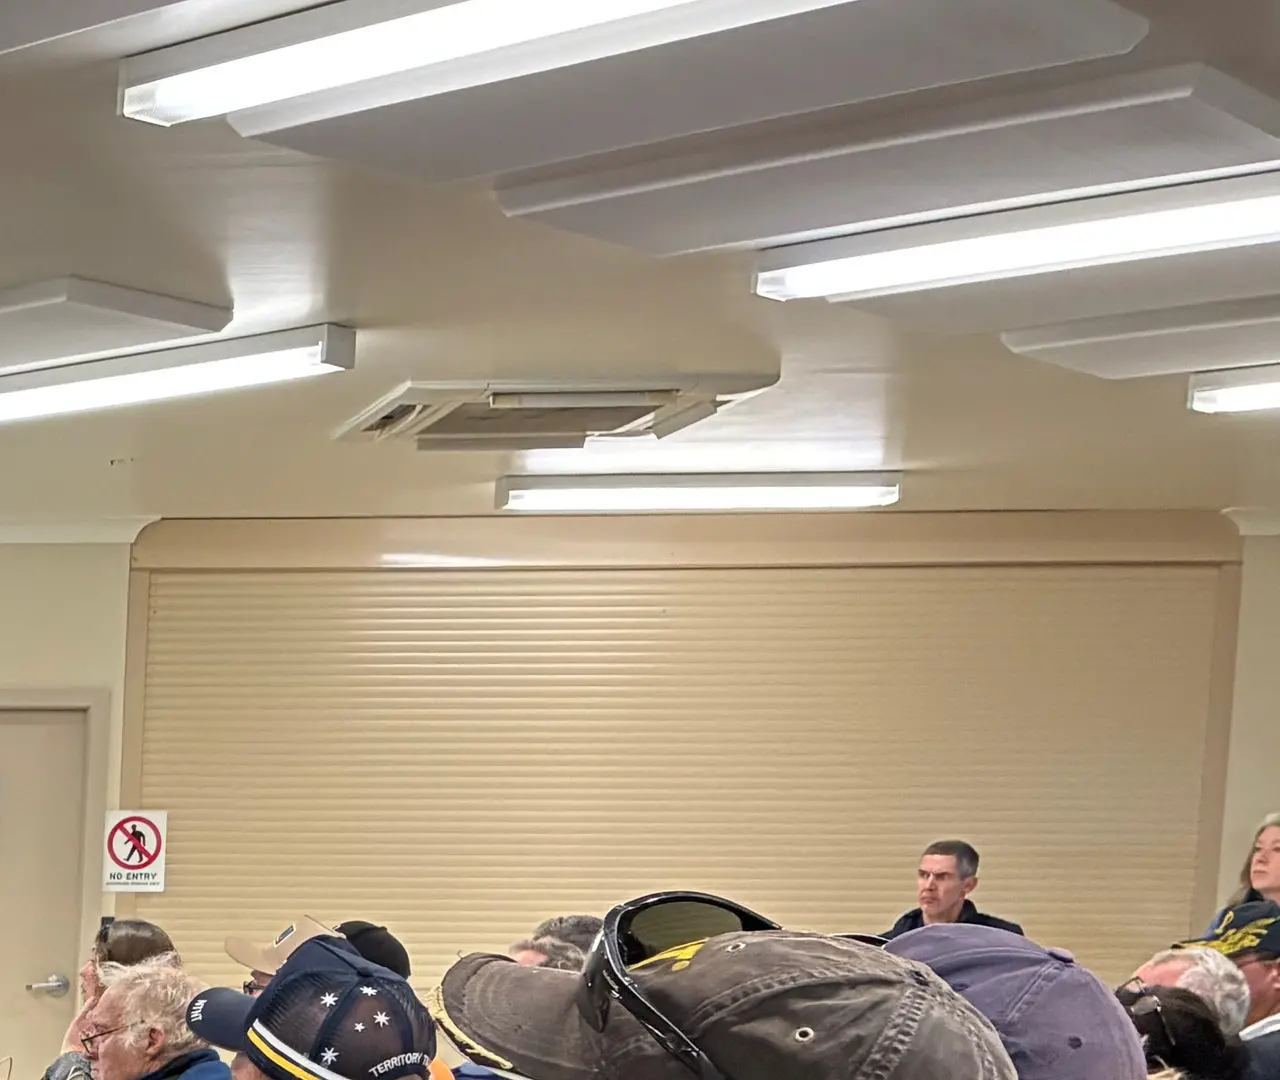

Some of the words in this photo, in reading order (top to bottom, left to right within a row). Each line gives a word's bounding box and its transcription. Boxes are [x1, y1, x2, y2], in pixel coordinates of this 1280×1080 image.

[109, 872, 123, 880] NO
[126, 872, 157, 880] ENTRY
[368, 1052, 423, 1077] TERRITORY
